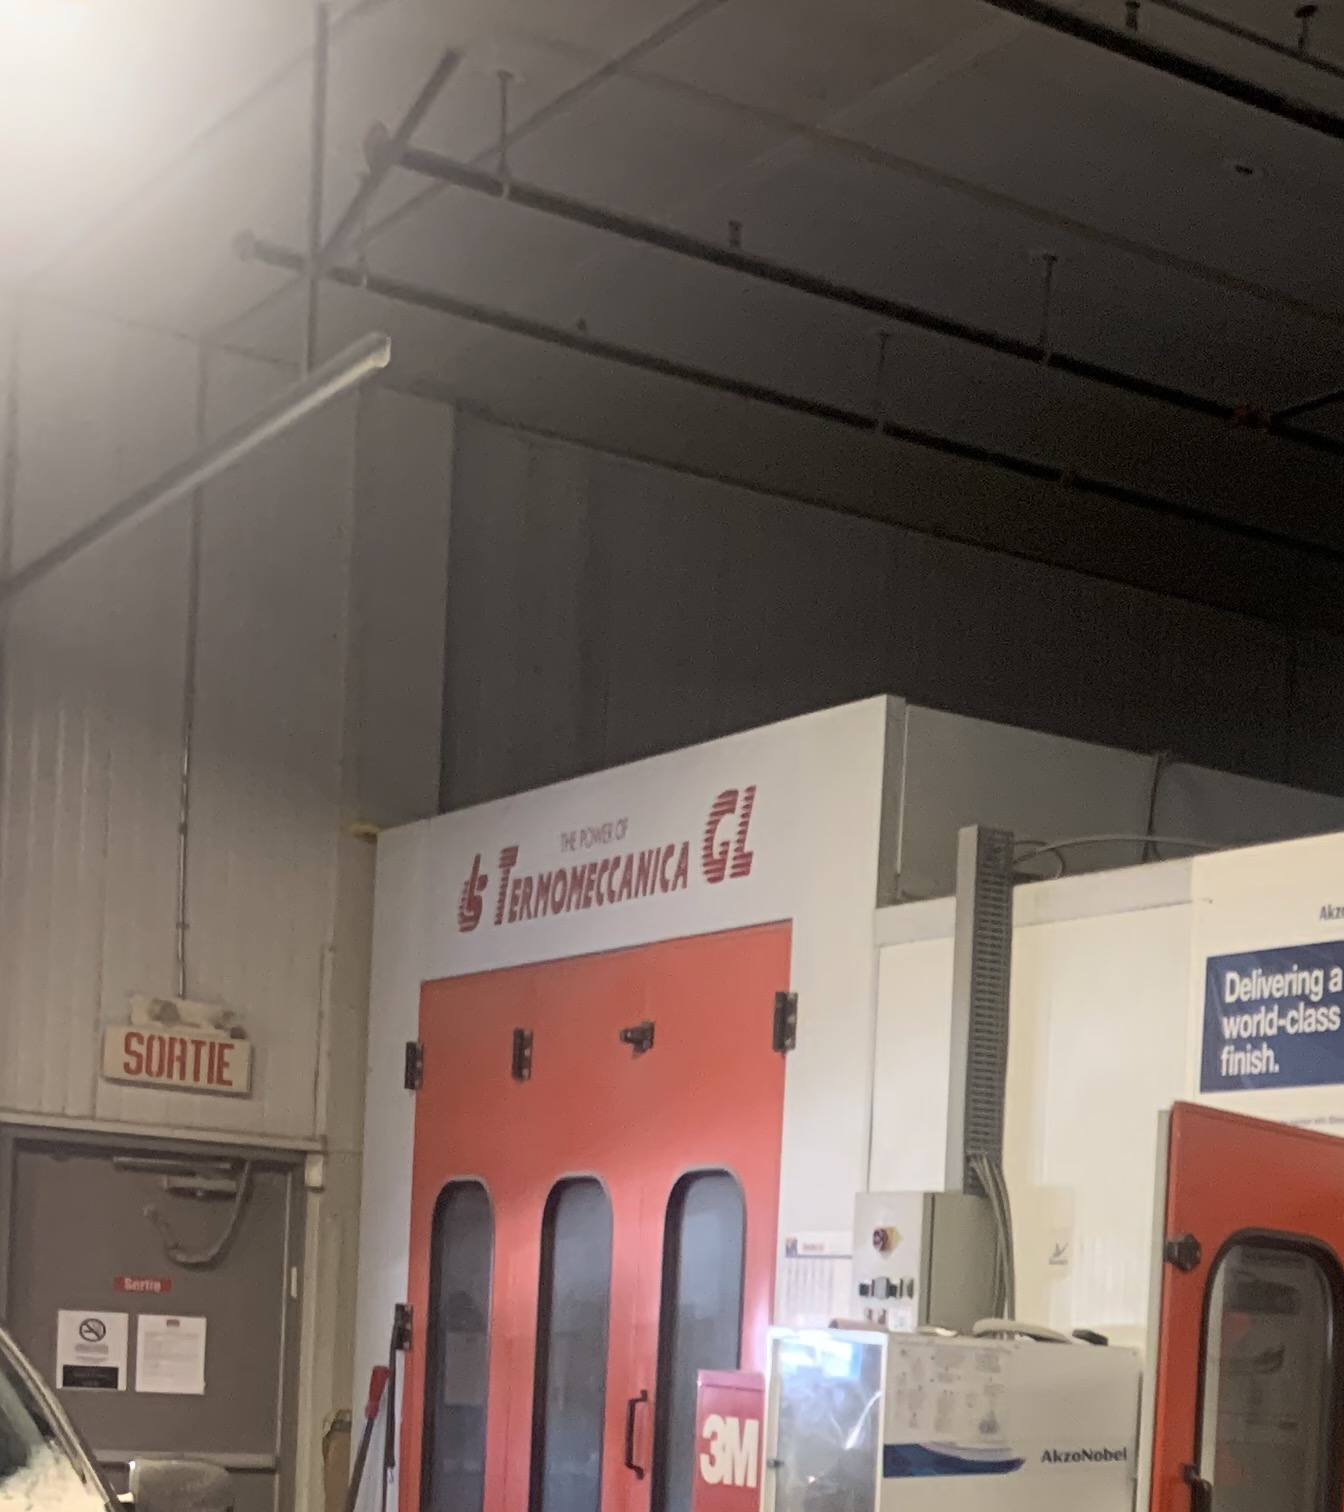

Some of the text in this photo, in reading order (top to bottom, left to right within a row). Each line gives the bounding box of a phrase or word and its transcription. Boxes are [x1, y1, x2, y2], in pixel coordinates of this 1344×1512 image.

[494, 840, 690, 925] TERMOMECCANICA
[702, 785, 756, 884] GL
[1224, 965, 1343, 1003] Delivering a
[1221, 1001, 1341, 1040] world-class
[123, 1031, 235, 1086] SORTIE
[1220, 1043, 1280, 1077] finish.
[700, 1413, 759, 1488] 3M
[1041, 1447, 1127, 1464] AkzoNobel
